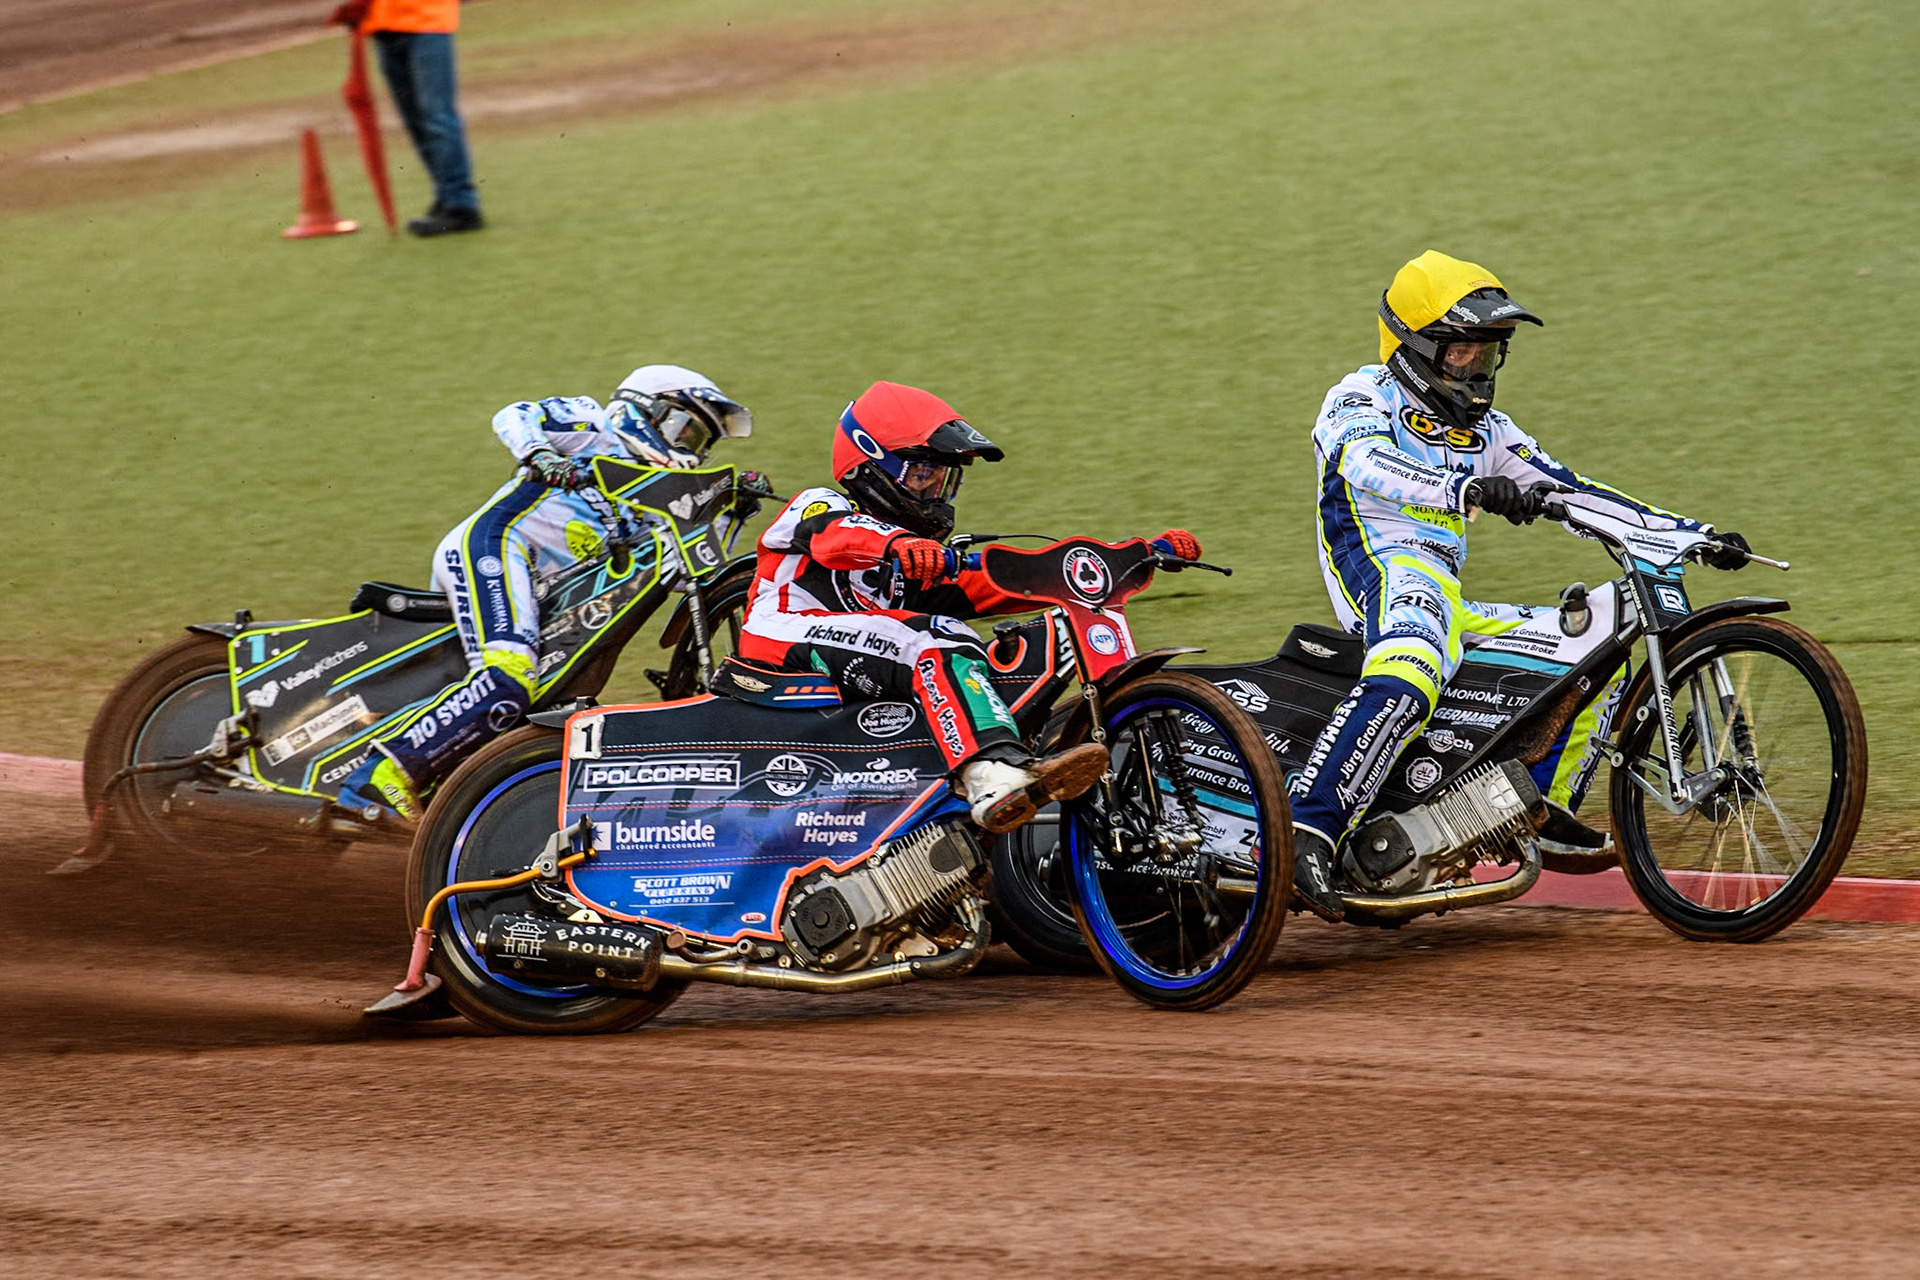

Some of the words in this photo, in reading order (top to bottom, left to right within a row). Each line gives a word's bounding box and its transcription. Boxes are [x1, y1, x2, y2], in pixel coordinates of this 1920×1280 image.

[1374, 459, 1411, 480] Insurance
[1411, 472, 1442, 487] Broker
[894, 572, 905, 597] CES
[804, 625, 861, 645] Richard
[1519, 628, 1562, 641] Grohmann
[1494, 639, 1530, 650] Insurance
[1530, 644, 1557, 656] Broker
[436, 670, 496, 727] LUCAS
[1507, 696, 1530, 707] LTD
[1392, 700, 1420, 738] Broker
[403, 715, 438, 749] OIL
[582, 722, 594, 753] 1
[1671, 744, 1683, 763] OIL
[1340, 750, 1364, 780] Jörg
[592, 768, 732, 786] POLCOPPER
[832, 768, 921, 786] MOTOREX
[831, 783, 845, 791] Oil
[861, 782, 918, 792] Switzerland
[796, 811, 866, 827] Richard
[616, 820, 716, 842] burnside
[803, 828, 859, 846] Hayes
[616, 843, 656, 851] chartered
[657, 841, 716, 850] accountants
[633, 878, 679, 892] SCOTT
[680, 875, 732, 889] BROWN
[555, 926, 651, 950] EASTERN
[568, 940, 634, 958] POINT
